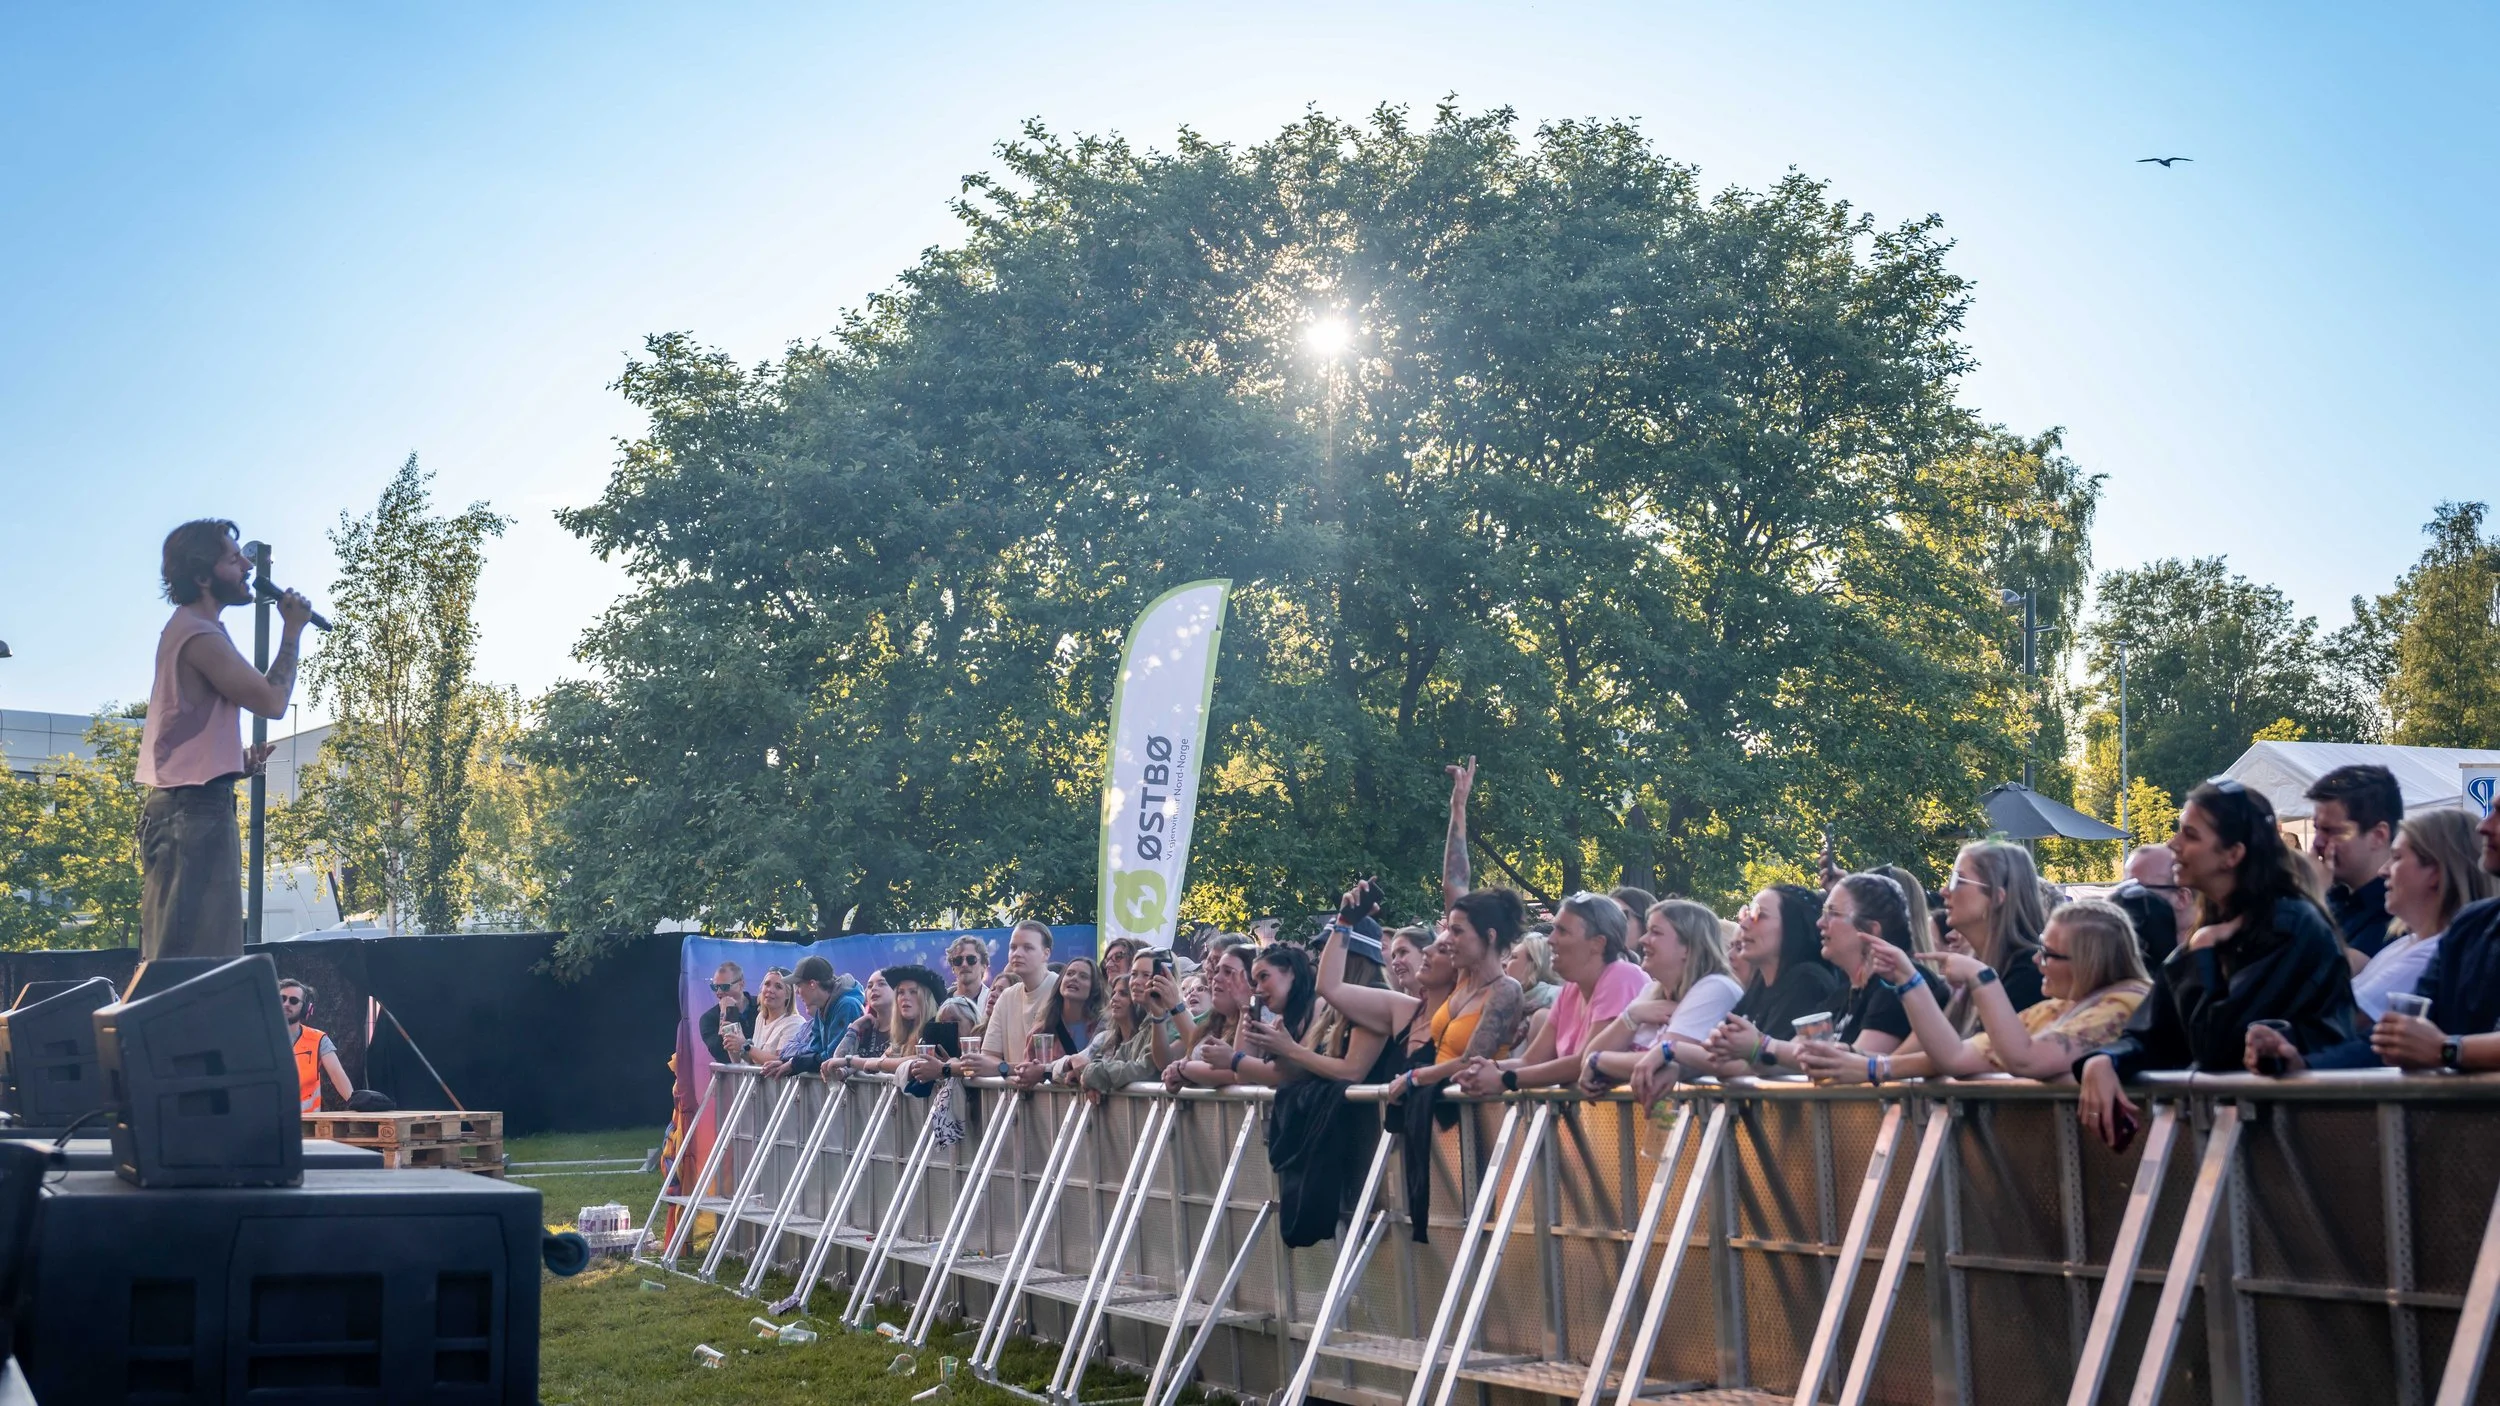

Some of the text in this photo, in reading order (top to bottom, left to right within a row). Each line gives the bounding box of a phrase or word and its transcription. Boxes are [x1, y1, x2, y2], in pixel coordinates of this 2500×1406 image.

[1137, 734, 1172, 861] ØSTBØ
[1166, 738, 1189, 861] Vi gjenvinr Nord-Norge
